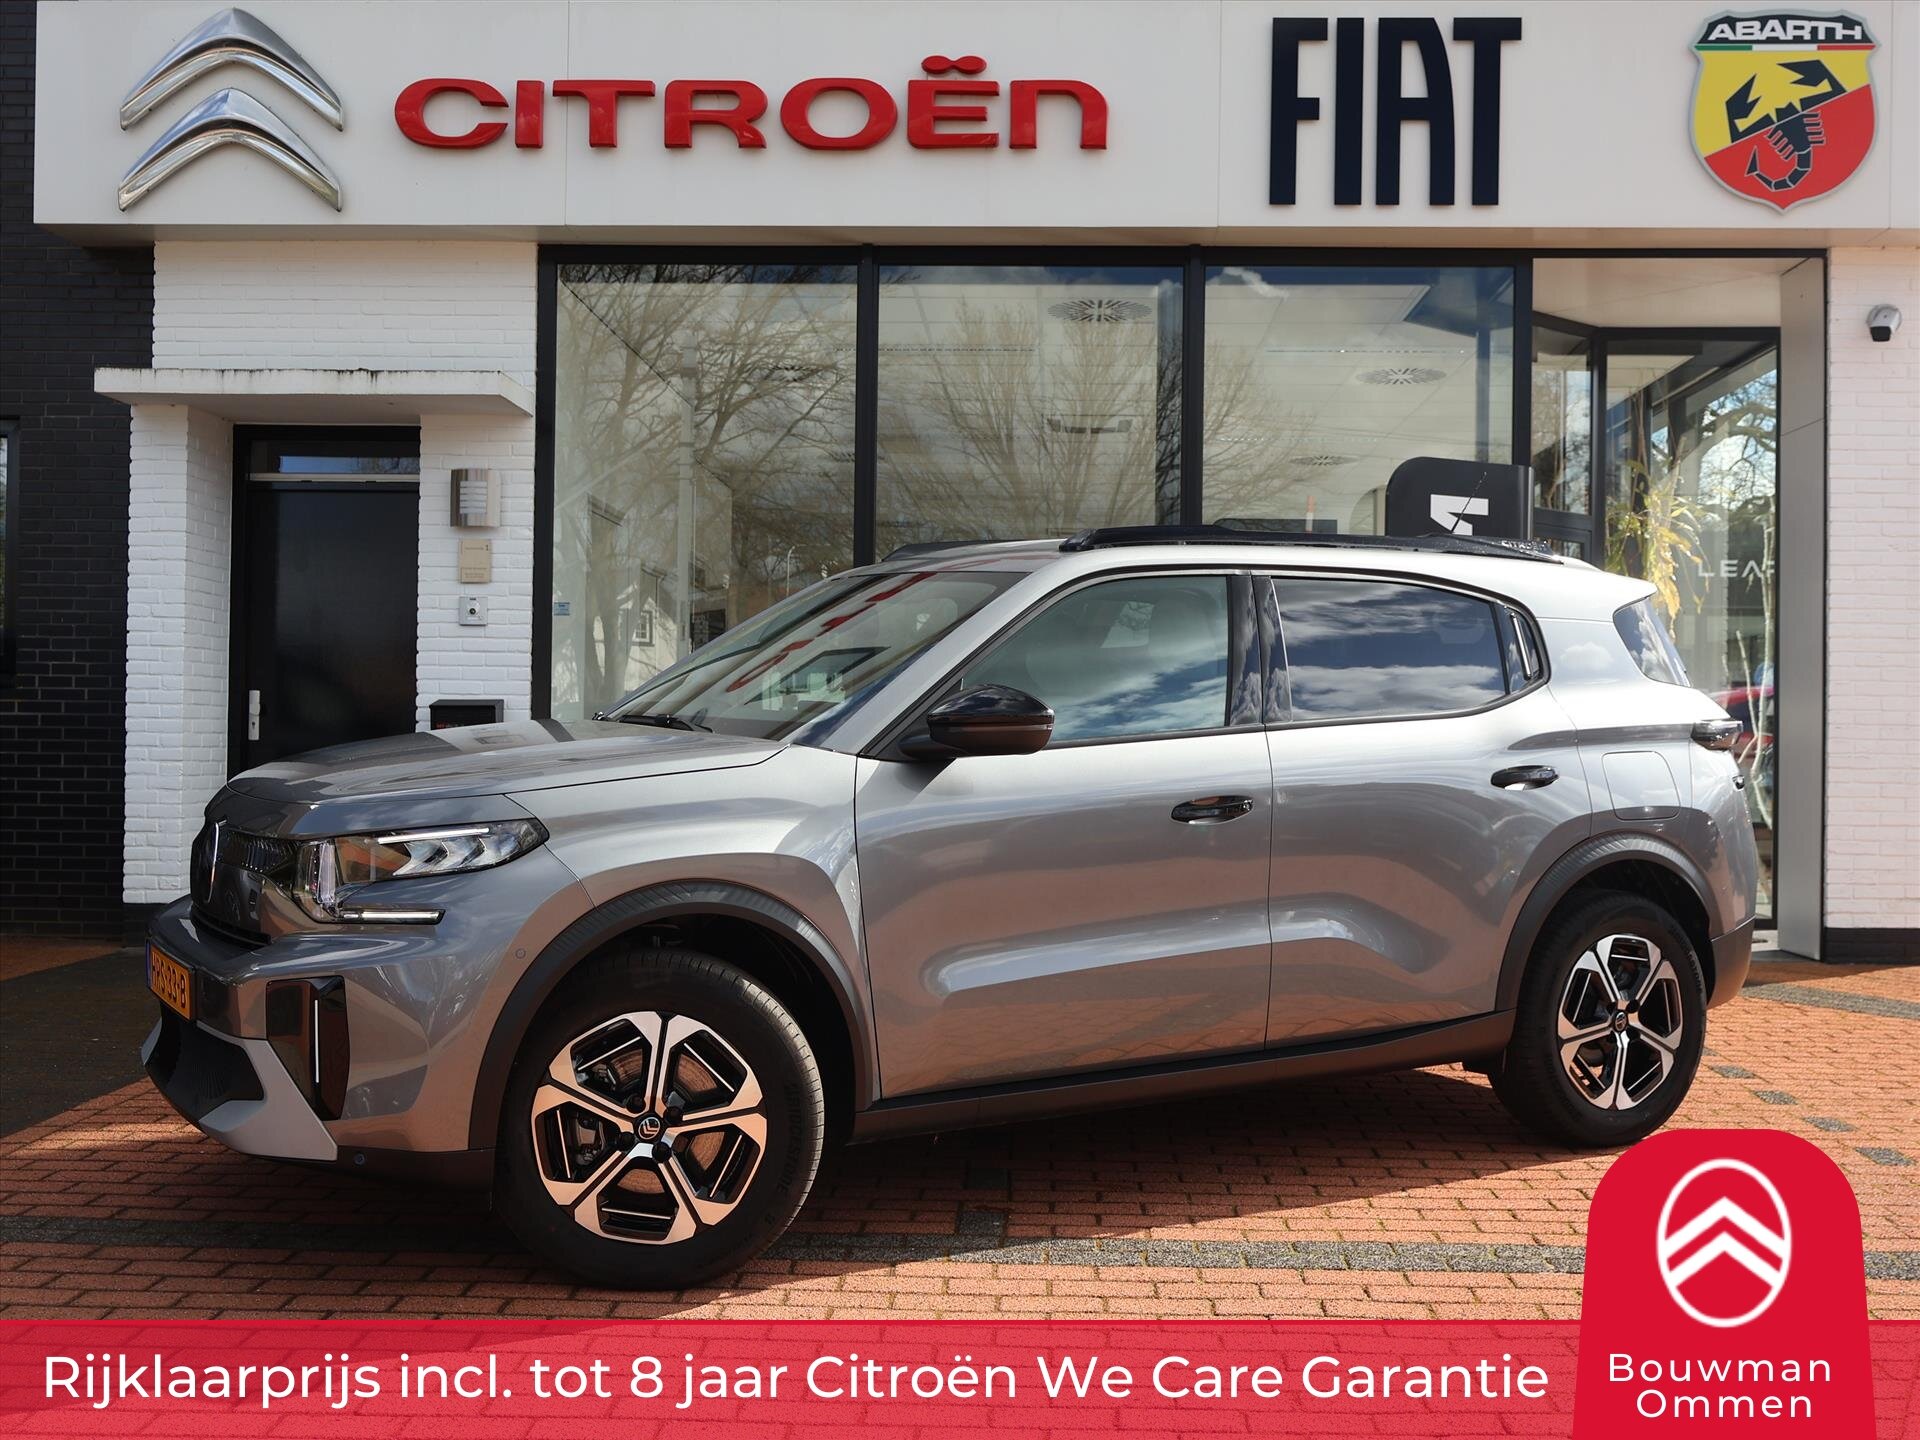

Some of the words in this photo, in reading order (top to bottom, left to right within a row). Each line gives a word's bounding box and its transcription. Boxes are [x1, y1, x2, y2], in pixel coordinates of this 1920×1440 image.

[1708, 19, 1862, 41] ABARTH
[395, 55, 1109, 149] CITROËN
[1269, 18, 1522, 207] FIAT
